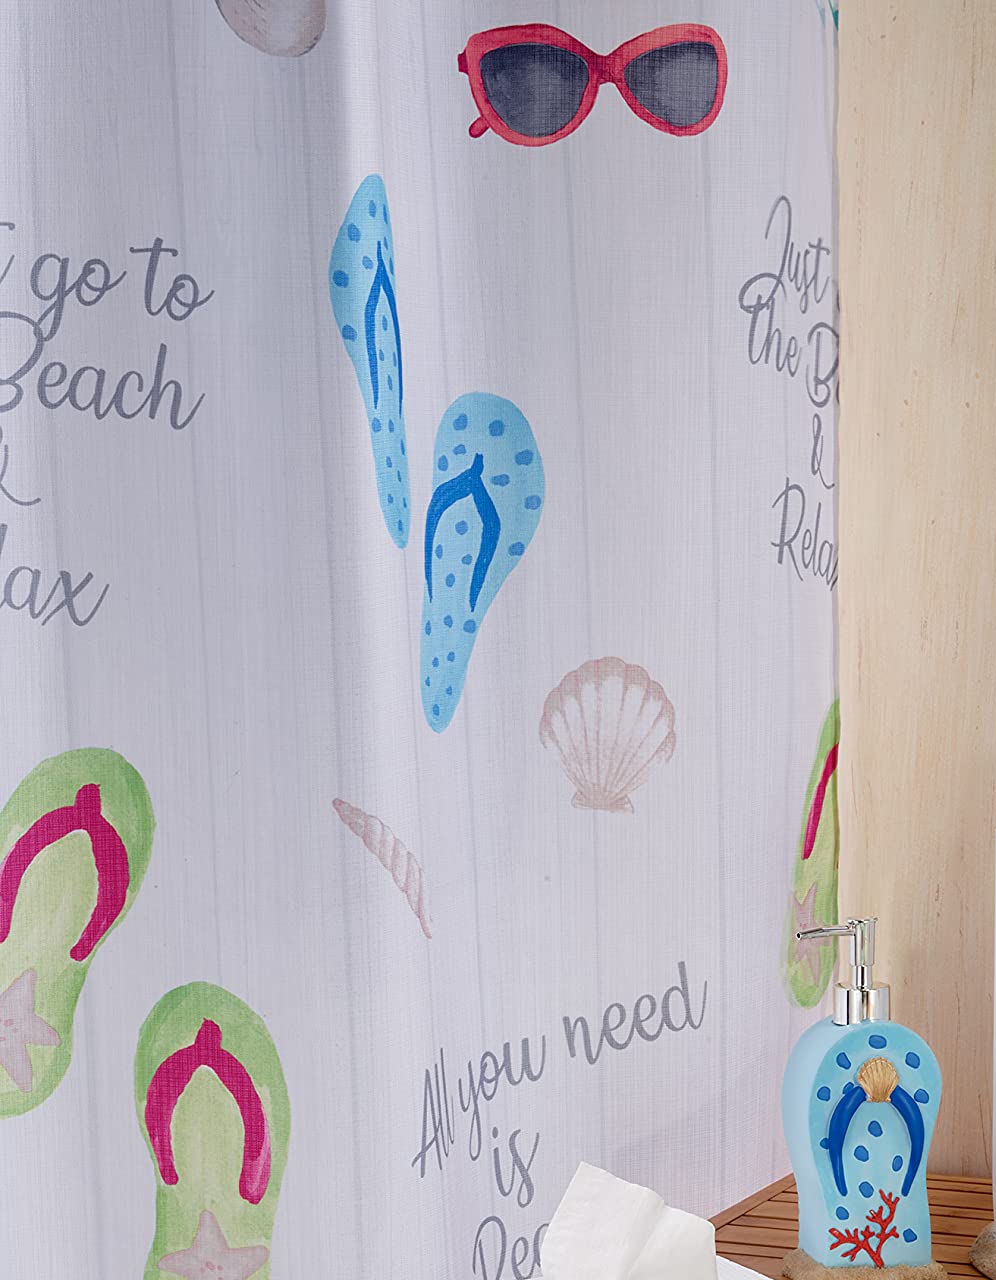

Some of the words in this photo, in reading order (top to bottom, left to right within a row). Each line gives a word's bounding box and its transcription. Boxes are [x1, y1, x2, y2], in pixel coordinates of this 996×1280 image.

[30, 253, 128, 342] go
[129, 237, 215, 321] to
[738, 195, 831, 314] Just
[740, 294, 802, 378] the
[810, 413, 836, 489] &
[411, 1048, 455, 1179] All
[458, 1035, 547, 1161] you
[562, 961, 708, 1065] need
[492, 1126, 540, 1208] is
